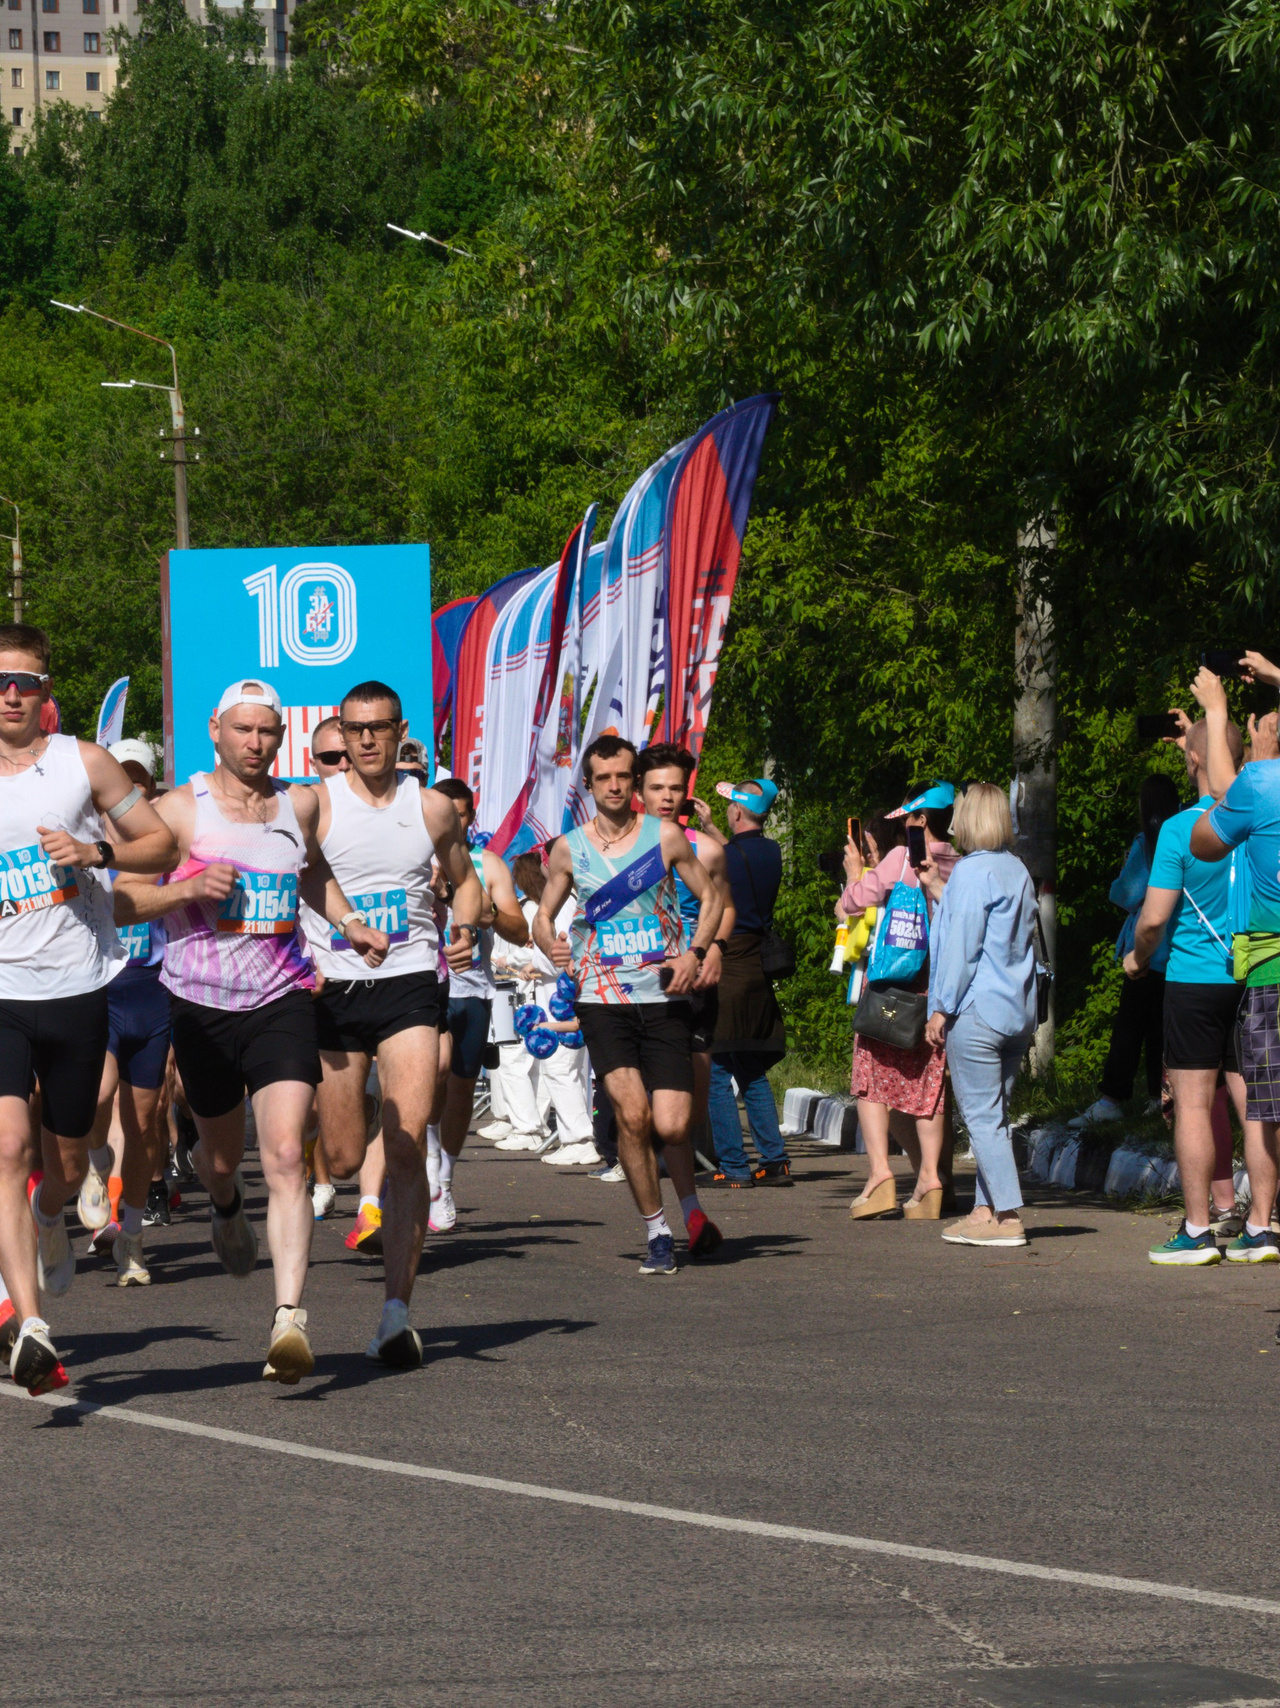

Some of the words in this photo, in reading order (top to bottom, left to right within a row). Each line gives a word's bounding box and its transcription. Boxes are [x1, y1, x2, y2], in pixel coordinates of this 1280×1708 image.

[242, 562, 358, 668] 10
[309, 595, 331, 614] ЗА
[1, 901, 17, 917] A
[228, 890, 290, 919] 70154
[602, 929, 658, 956] 50301
